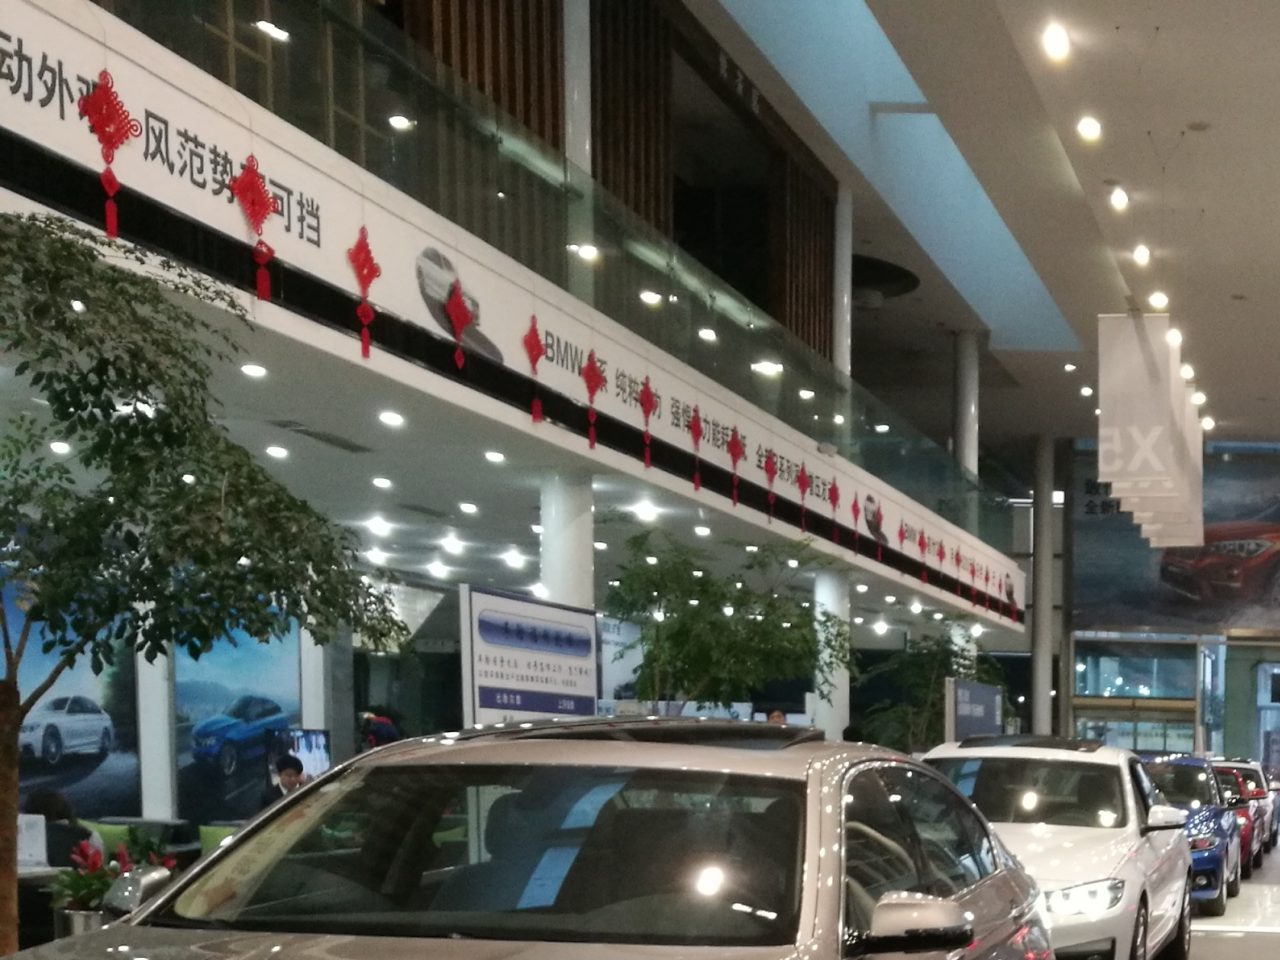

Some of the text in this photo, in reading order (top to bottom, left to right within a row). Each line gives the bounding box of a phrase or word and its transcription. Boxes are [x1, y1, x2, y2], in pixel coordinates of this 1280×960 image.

[0, 30, 321, 248] 动外 风范势可挡
[544, 330, 583, 377] BMW
